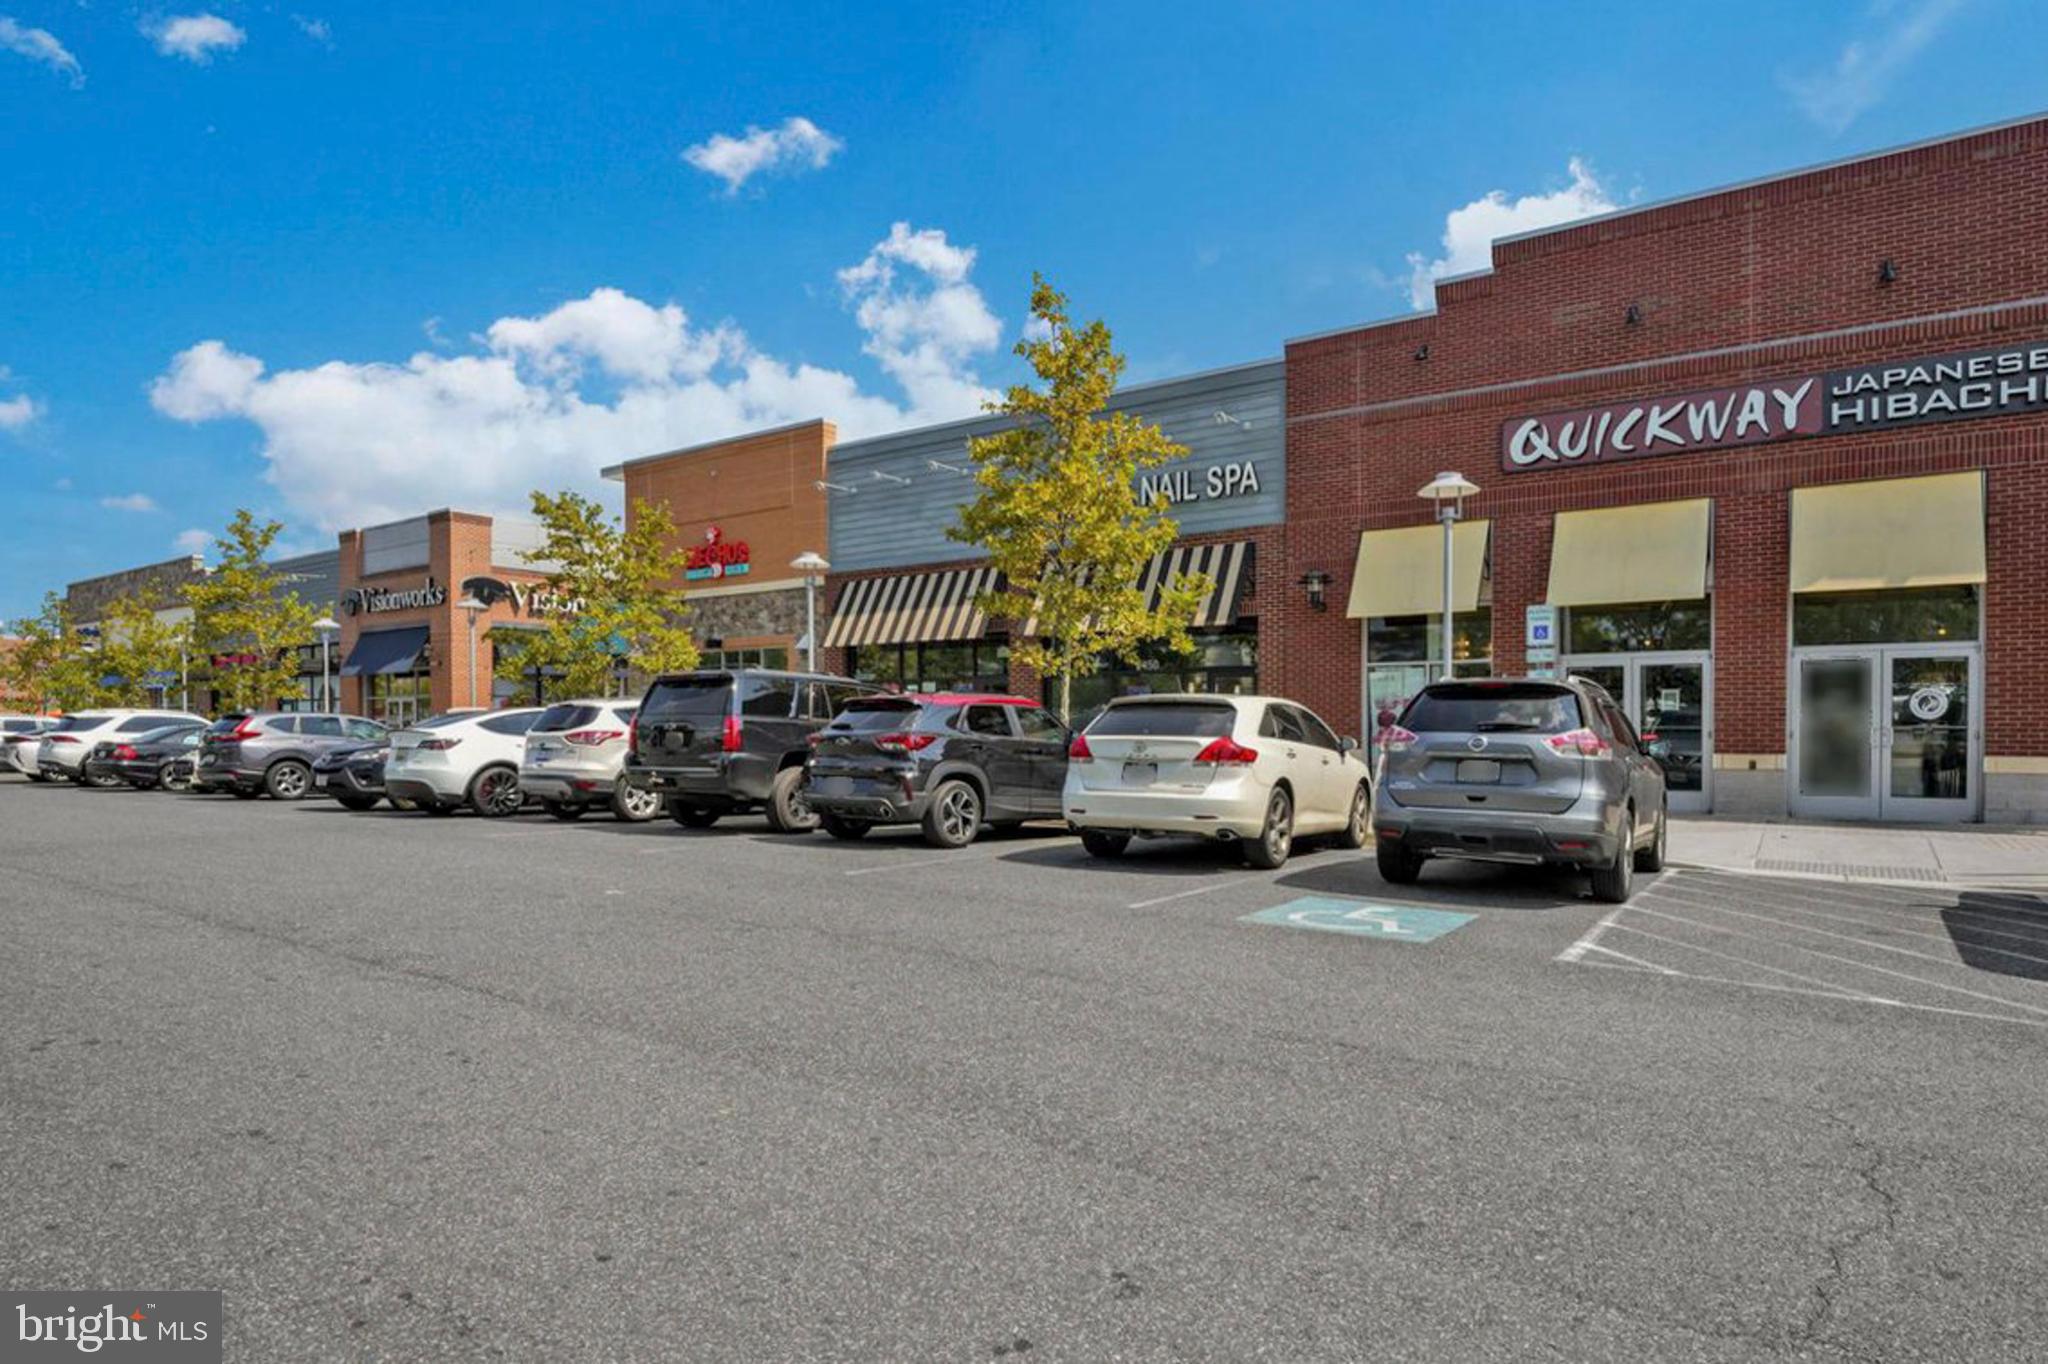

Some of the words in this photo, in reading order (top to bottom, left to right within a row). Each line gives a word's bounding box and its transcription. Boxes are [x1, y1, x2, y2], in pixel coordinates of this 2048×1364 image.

[1832, 347, 2048, 396] JAPANESE
[1508, 377, 1815, 465] QUICKWAY
[1140, 470, 1198, 506] NAIL
[1206, 461, 1259, 499] SPA
[352, 577, 448, 614] Visionworks
